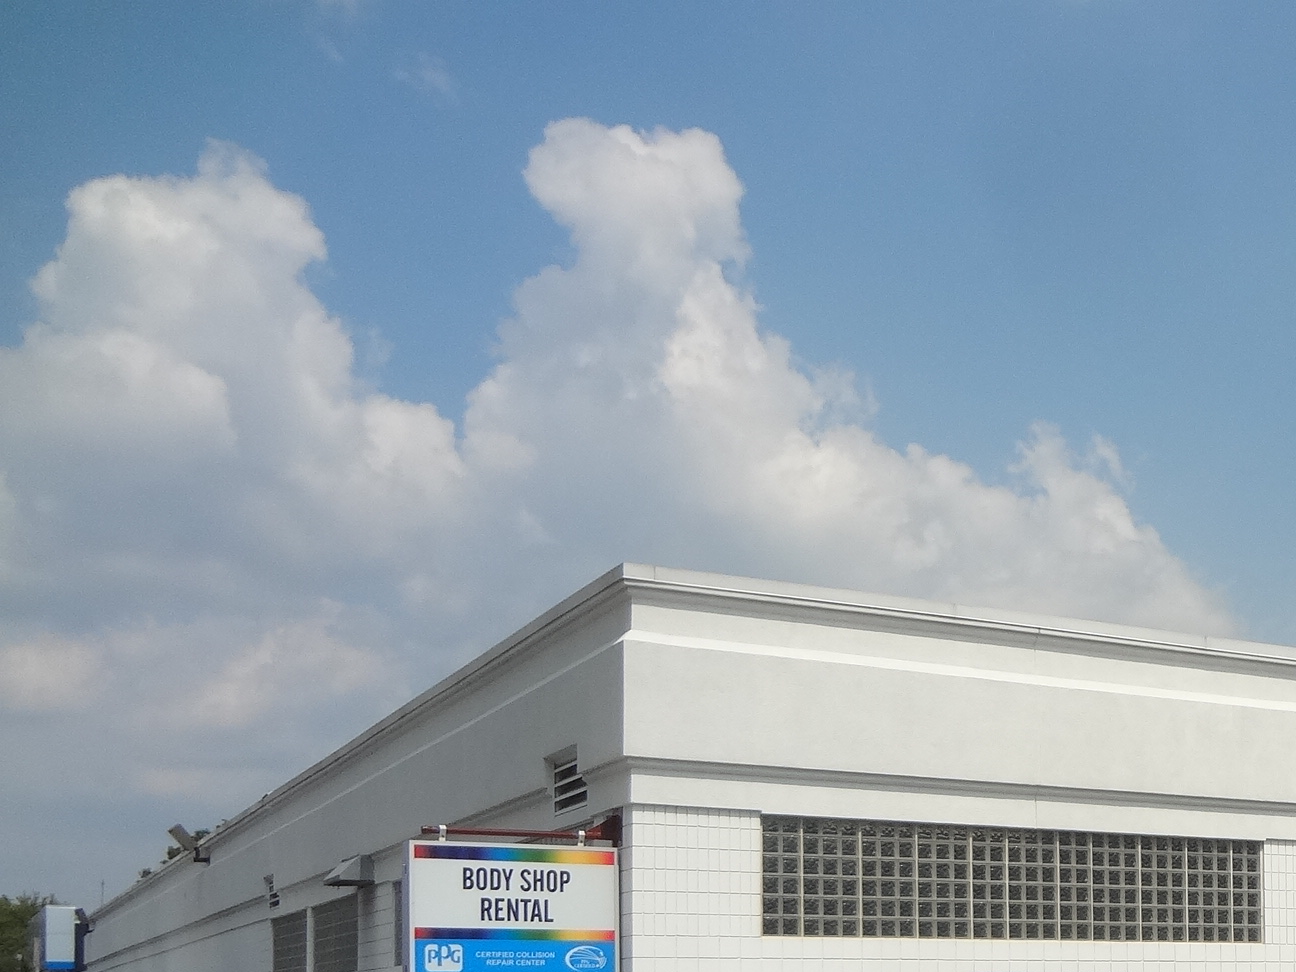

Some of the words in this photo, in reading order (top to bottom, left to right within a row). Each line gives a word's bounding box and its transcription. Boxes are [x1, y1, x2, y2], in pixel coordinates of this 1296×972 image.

[462, 866, 514, 891] BODY
[520, 868, 571, 893] SHOP
[480, 897, 554, 922] RENTAL
[427, 945, 461, 967] PPG
[475, 951, 515, 959] CERTIFIED
[516, 951, 555, 959] COLLISION
[486, 959, 515, 967] REPAIR
[516, 959, 546, 967] CENTER
